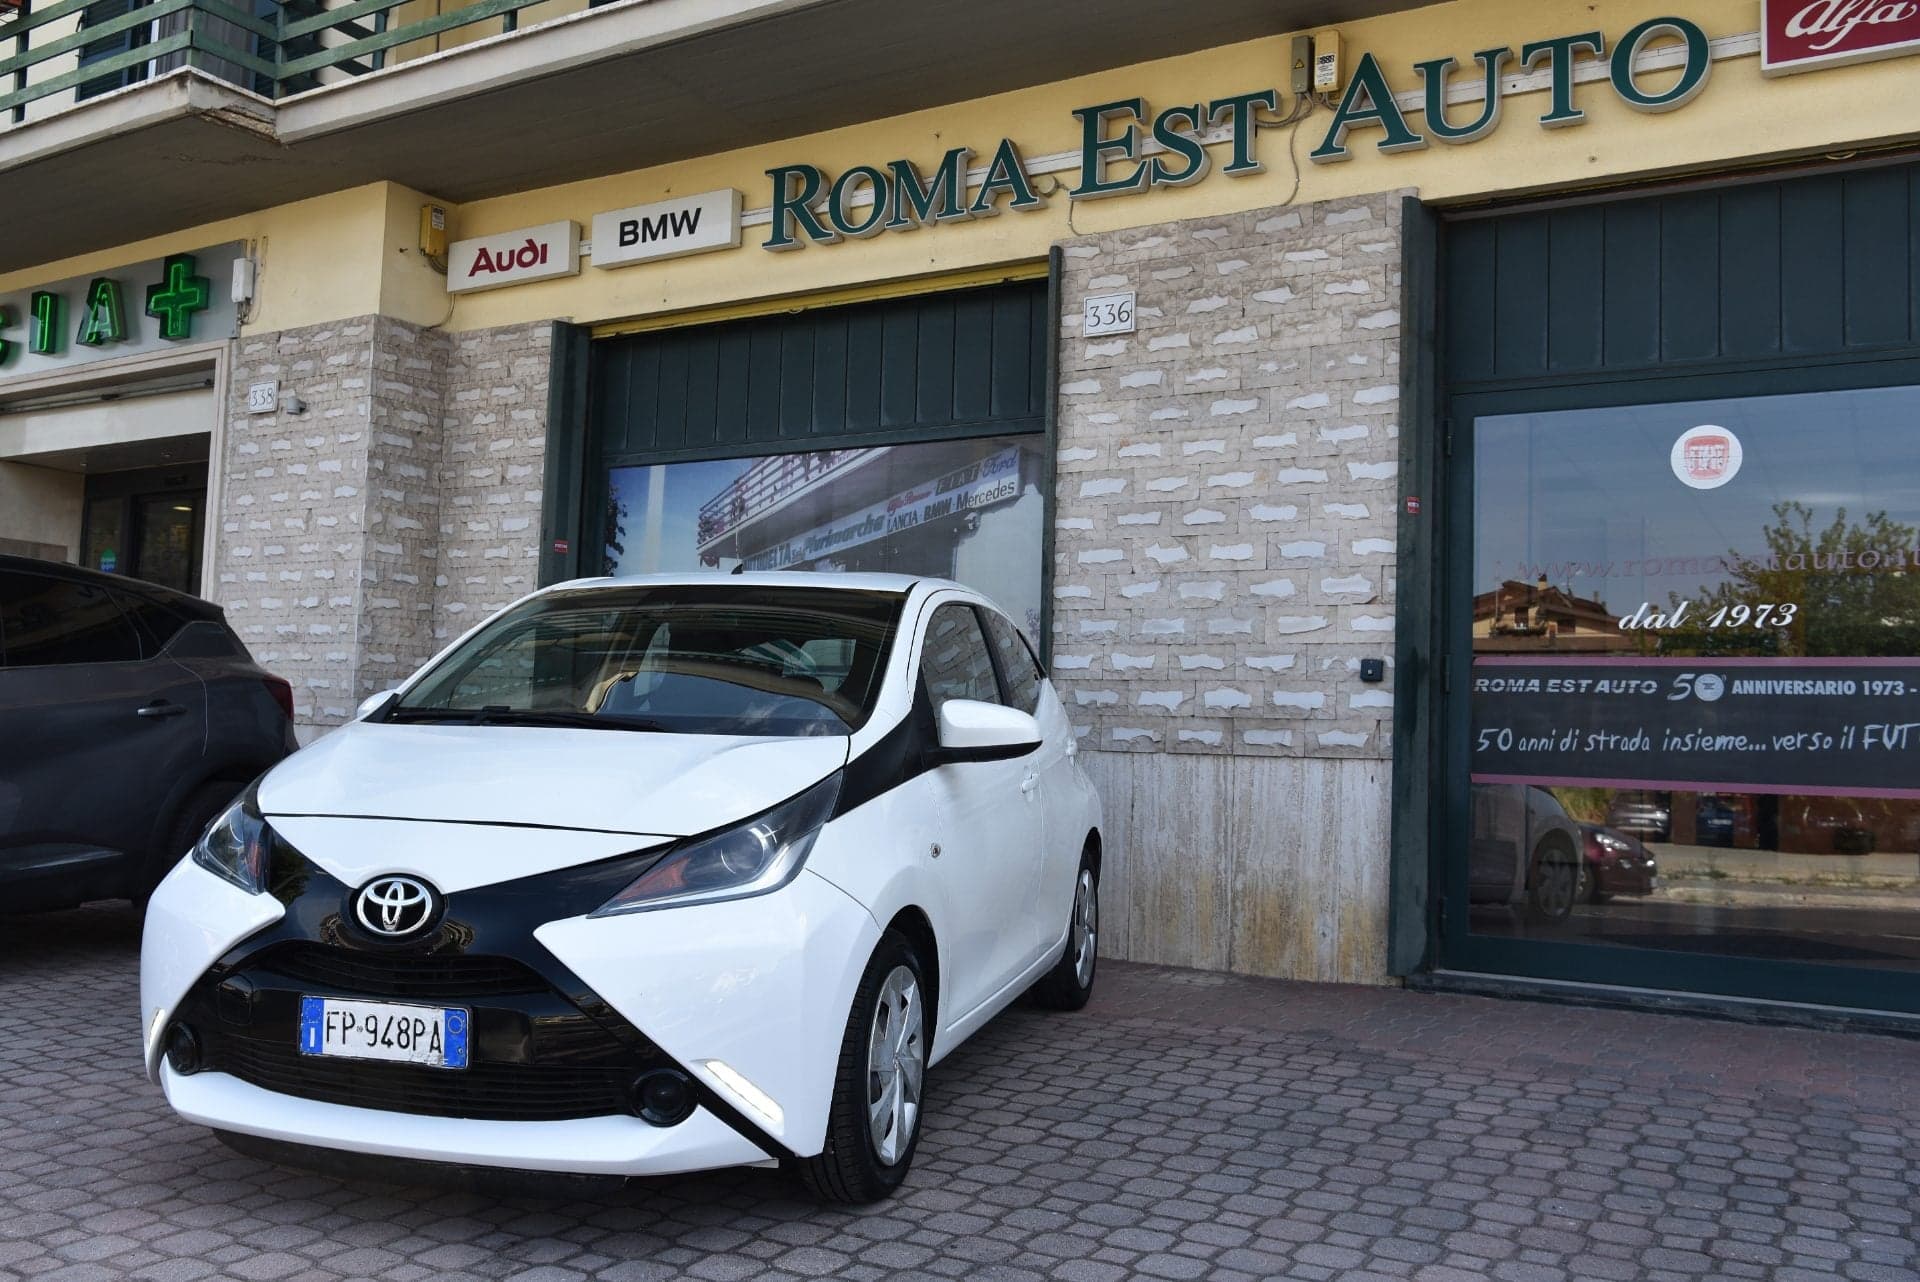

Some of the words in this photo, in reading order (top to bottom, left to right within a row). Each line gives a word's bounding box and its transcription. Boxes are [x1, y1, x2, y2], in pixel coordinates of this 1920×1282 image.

[1784, 0, 1917, 50] Alfa
[763, 138, 1041, 252] ROMA
[1069, 88, 1281, 199] EST
[1309, 16, 1710, 163] AUTO
[619, 207, 702, 248] BMW
[468, 238, 548, 276] Audi
[1087, 300, 1131, 328] 336
[251, 387, 275, 407] 338
[887, 509, 918, 533] LANCIA
[924, 496, 952, 522] BMW
[956, 479, 1015, 511] Mercedes
[1618, 600, 1690, 631] dal
[1706, 602, 1799, 629] 1973
[1474, 678, 1540, 693] ROMA
[1545, 679, 1593, 694] EST
[1594, 679, 1658, 695] AUTO
[1731, 679, 1857, 696] ANNIVERSARIO
[1862, 680, 1905, 696] 1973
[1476, 728, 1513, 752] 50
[1518, 729, 1557, 752] anni
[1559, 728, 1580, 752] di
[1584, 727, 1650, 752] strada
[1839, 725, 1856, 751] il
[1862, 723, 1920, 751] FUT
